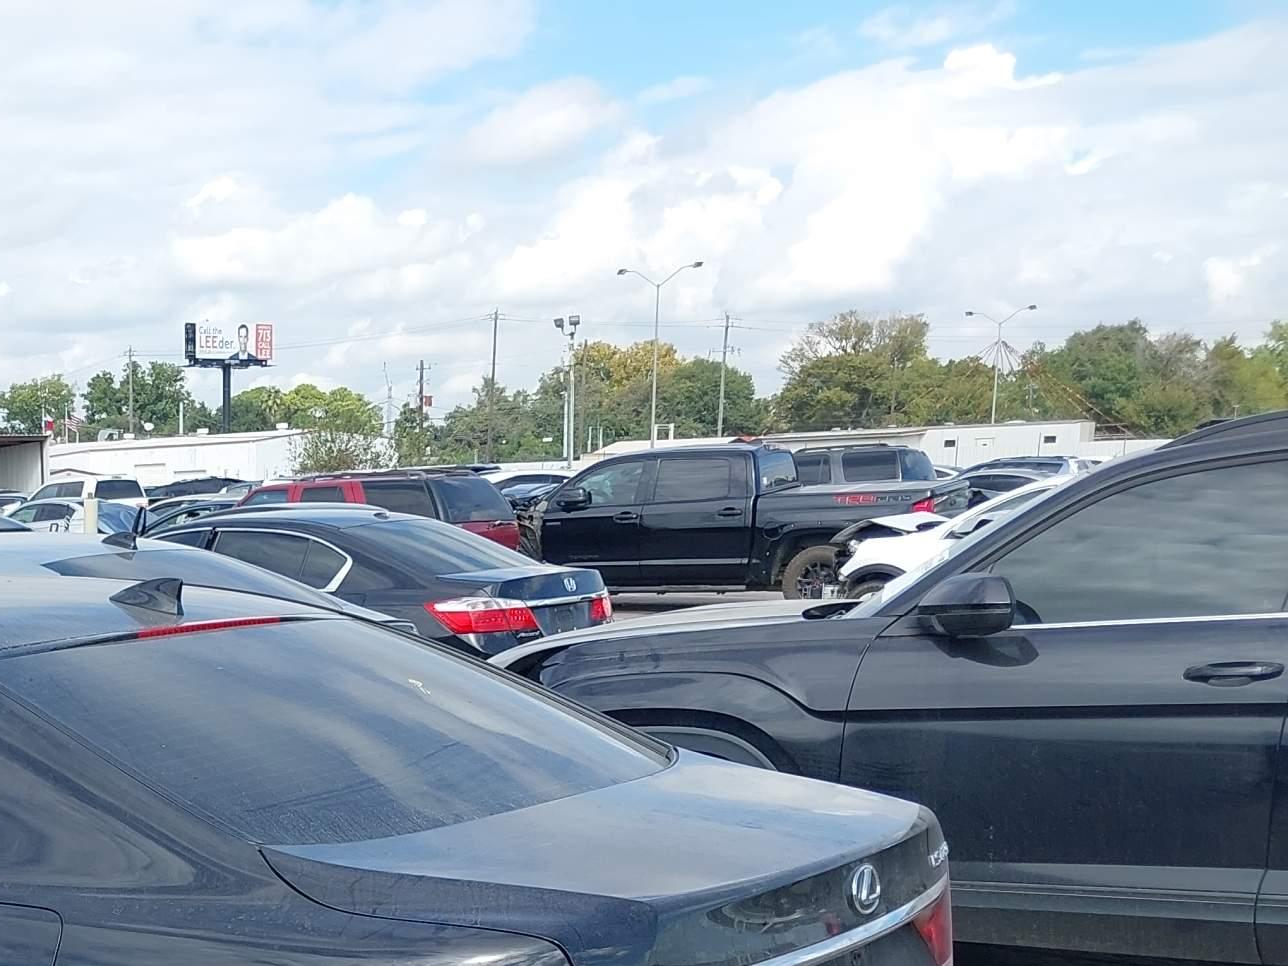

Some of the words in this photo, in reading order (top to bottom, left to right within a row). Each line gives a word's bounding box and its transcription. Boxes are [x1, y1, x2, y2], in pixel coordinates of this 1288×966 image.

[199, 326, 211, 335] Call
[212, 326, 222, 335] the
[257, 329, 271, 342] 713
[257, 349, 271, 359] LEE
